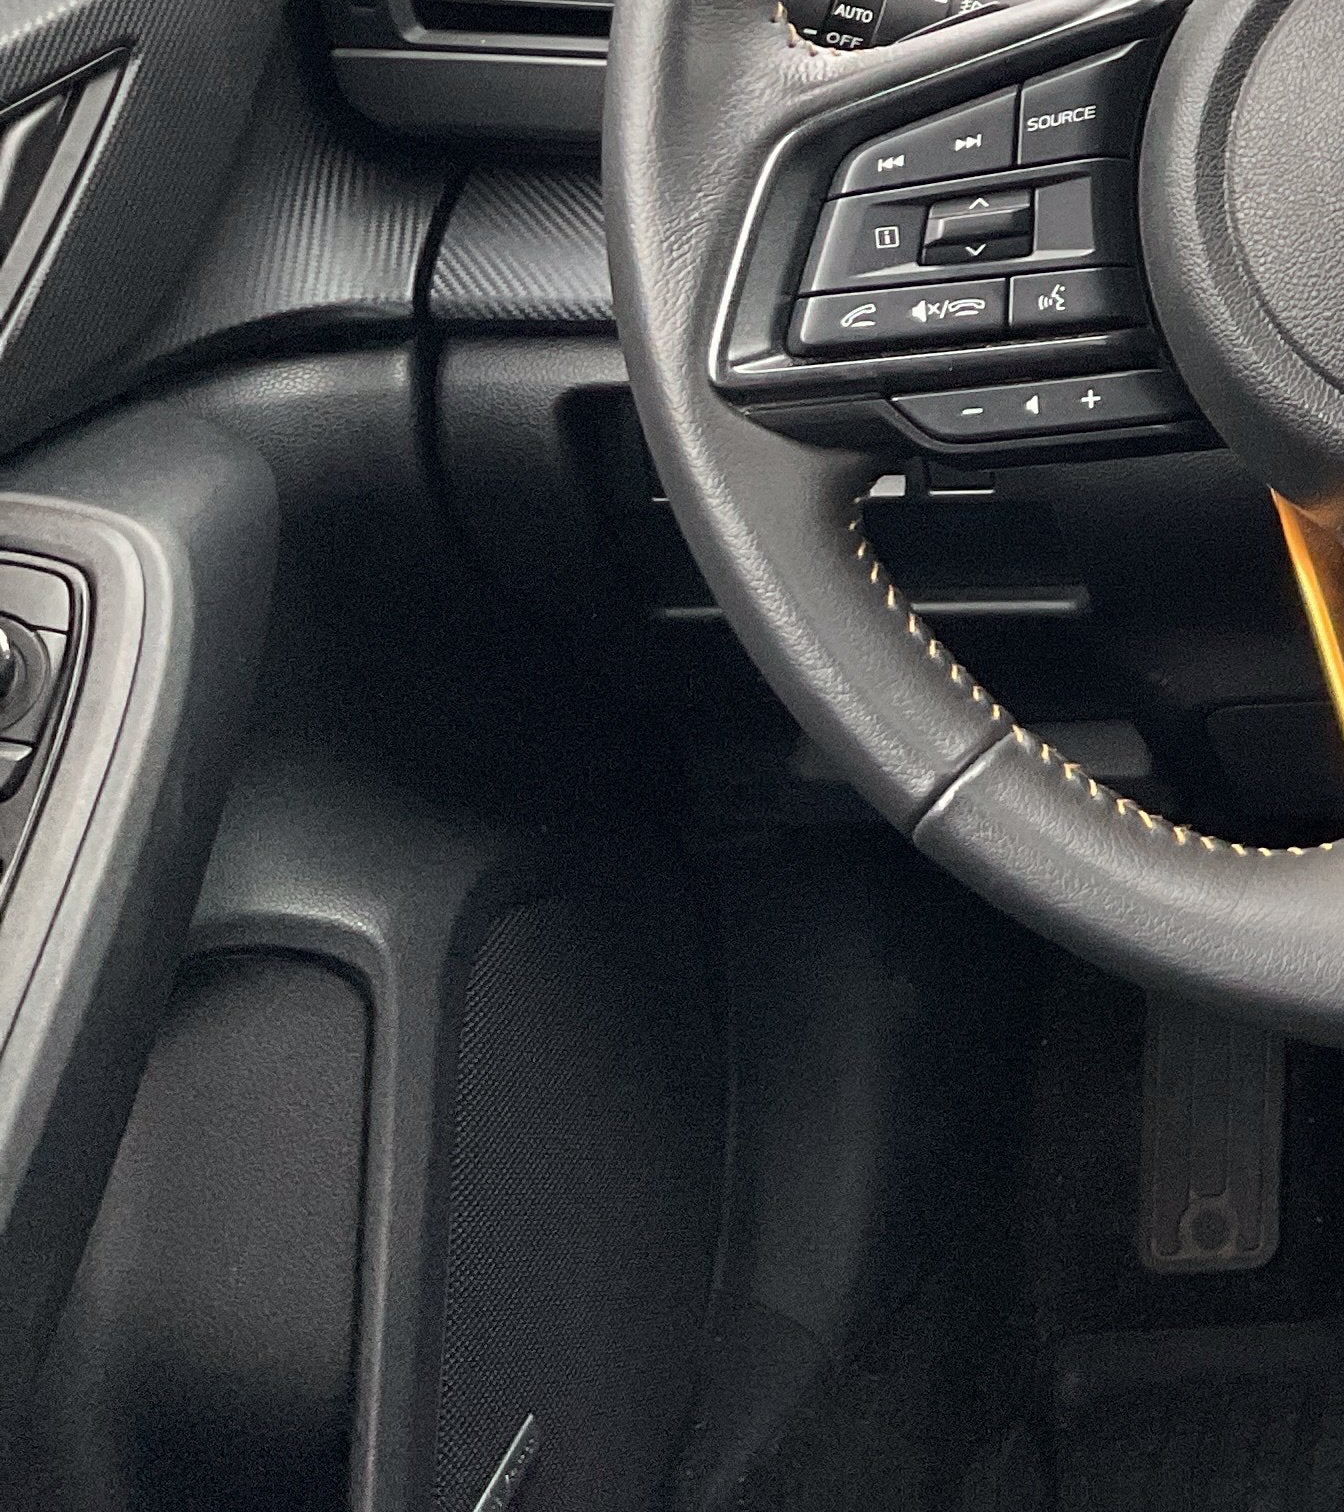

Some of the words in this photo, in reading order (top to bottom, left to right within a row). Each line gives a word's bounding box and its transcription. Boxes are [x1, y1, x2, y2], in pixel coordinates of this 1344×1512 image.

[833, 2, 874, 25] AUTO
[826, 31, 864, 50] OFF
[1026, 104, 1097, 131] SOURCE
